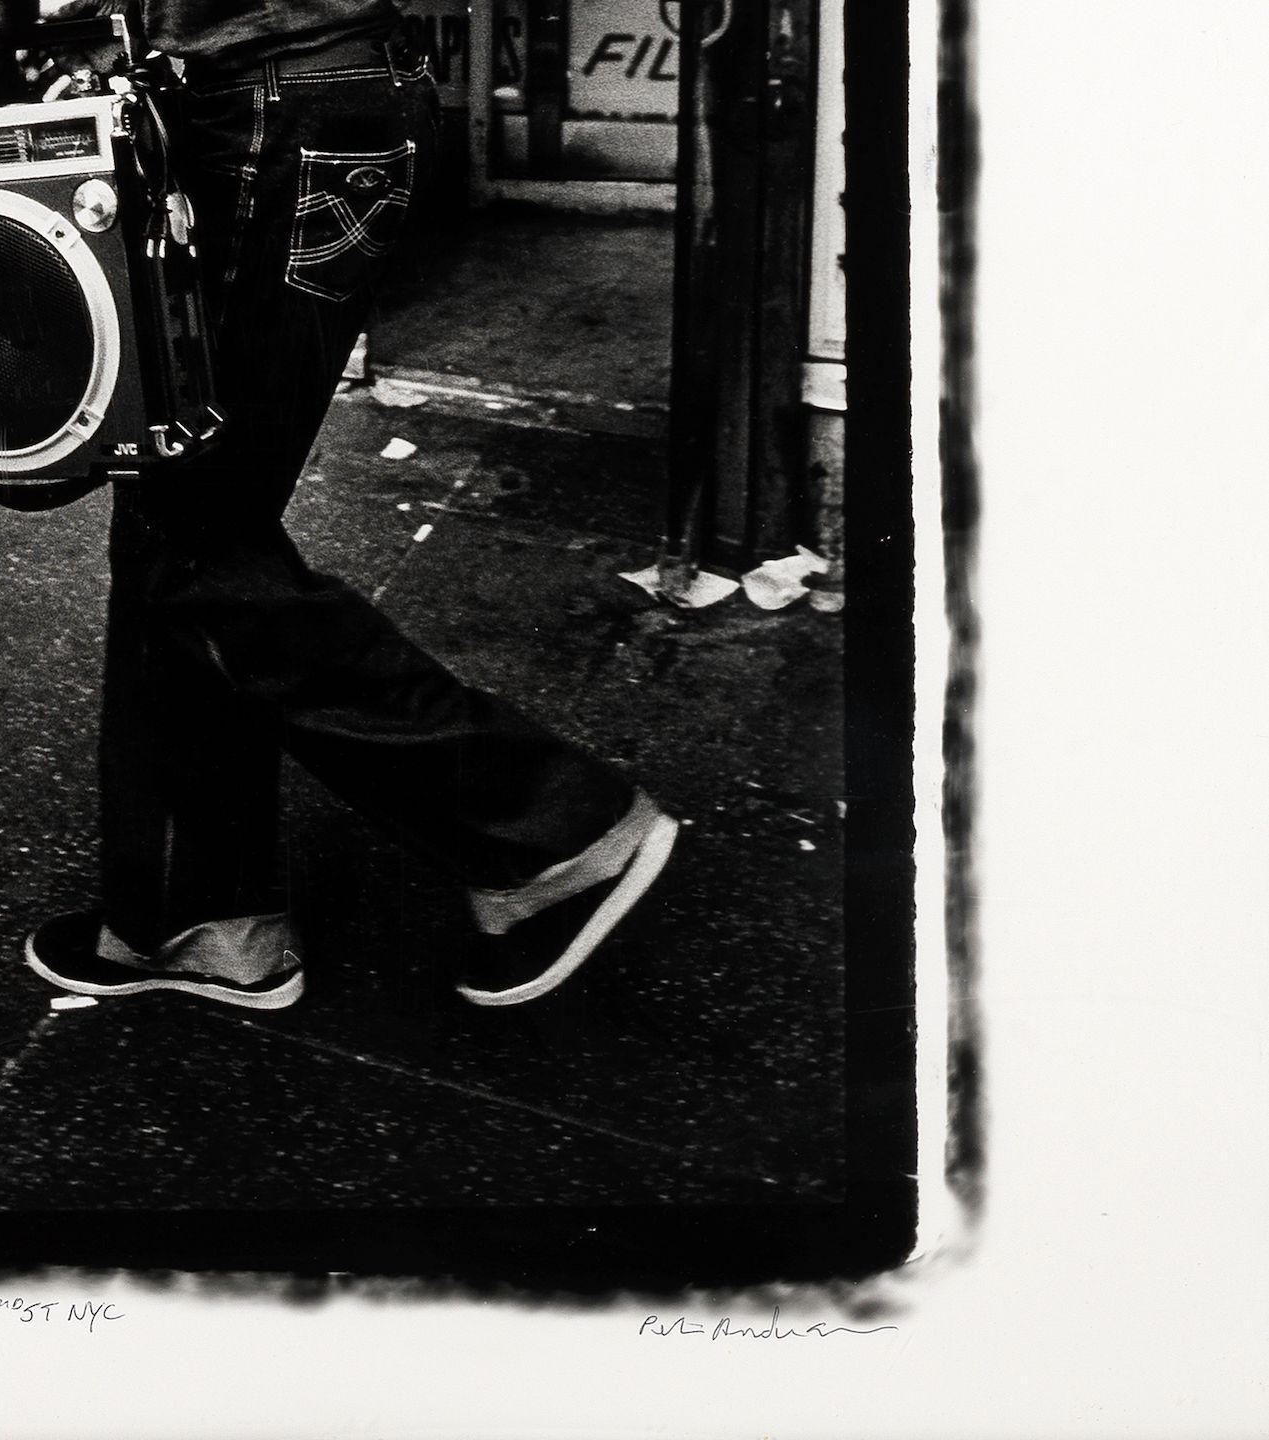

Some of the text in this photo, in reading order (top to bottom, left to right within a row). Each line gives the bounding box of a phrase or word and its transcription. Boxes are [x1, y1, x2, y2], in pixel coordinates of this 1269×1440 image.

[582, 33, 676, 81] FIL
[114, 443, 138, 456] JVC
[67, 1300, 126, 1333] NYC
